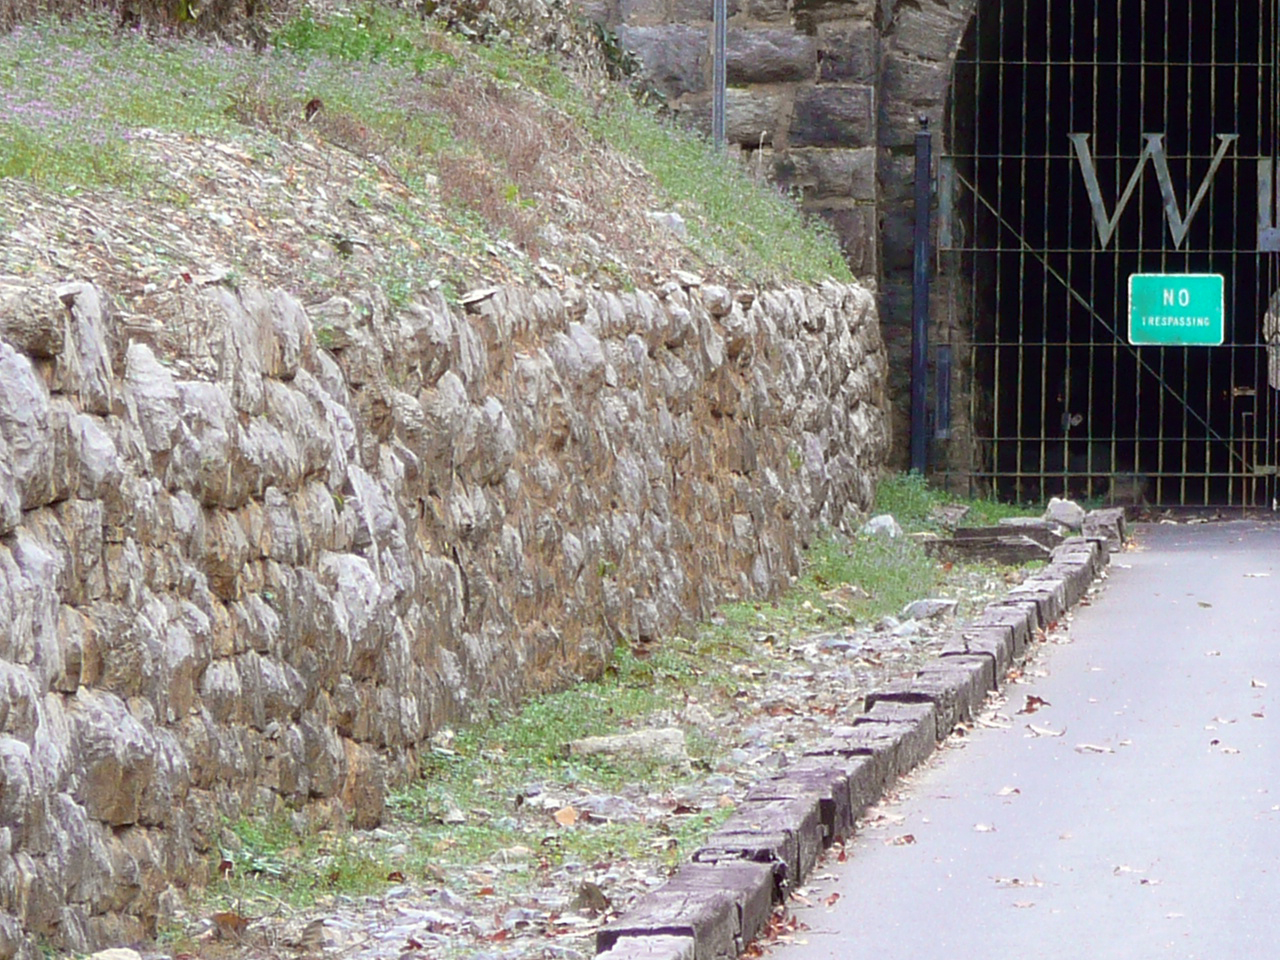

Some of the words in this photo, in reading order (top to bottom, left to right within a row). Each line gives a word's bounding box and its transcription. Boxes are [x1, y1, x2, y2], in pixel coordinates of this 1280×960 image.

[1066, 132, 1240, 250] W
[1162, 288, 1191, 307] NO
[1141, 315, 1211, 328] TRESPASSING
